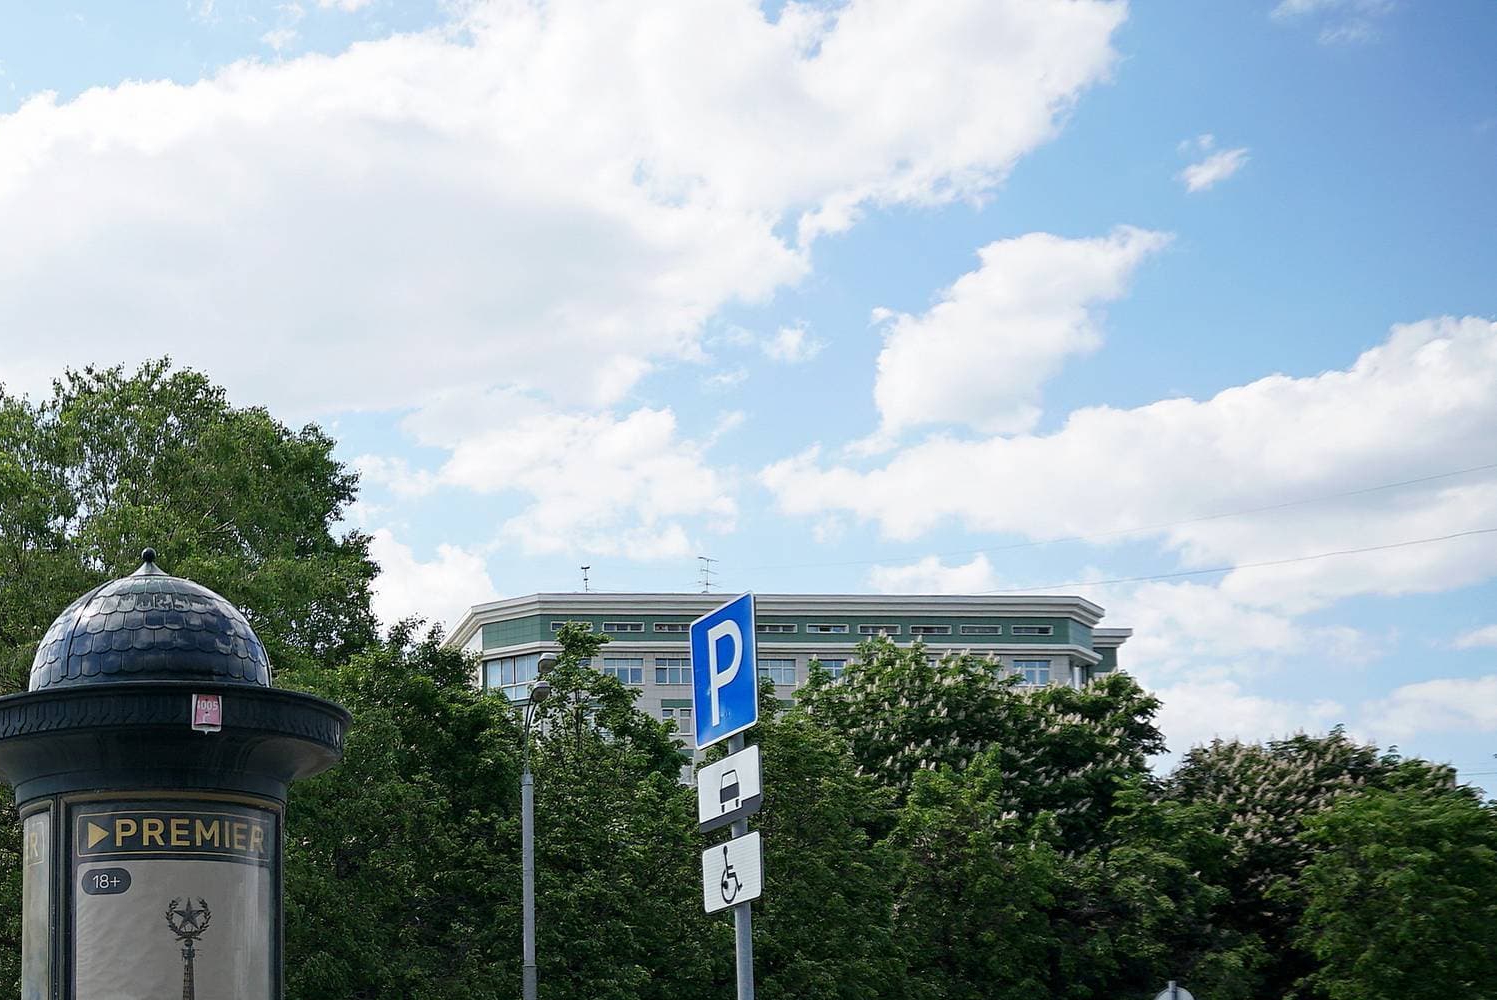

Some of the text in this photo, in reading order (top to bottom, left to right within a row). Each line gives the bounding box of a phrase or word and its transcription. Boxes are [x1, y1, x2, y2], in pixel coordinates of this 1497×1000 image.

[707, 619, 743, 727] P
[114, 818, 264, 853] PREMIER
[92, 874, 121, 889] 18+
